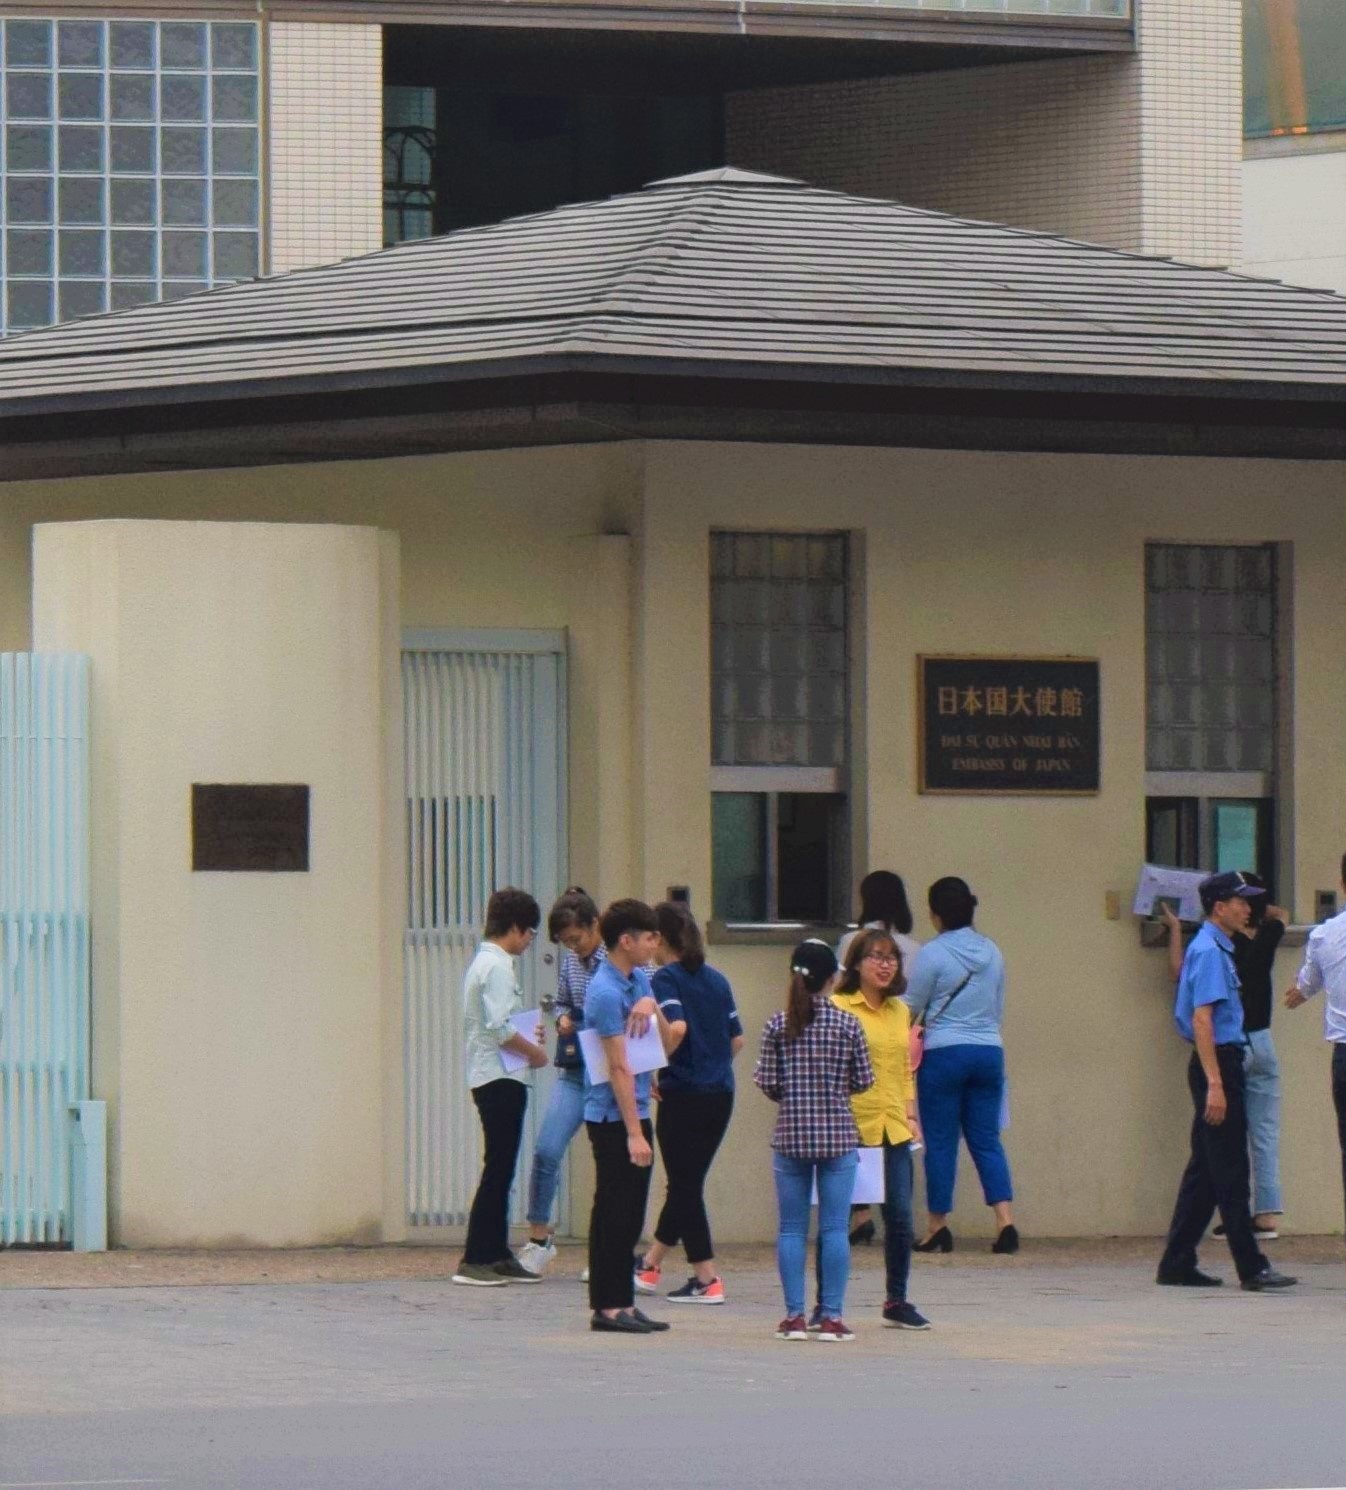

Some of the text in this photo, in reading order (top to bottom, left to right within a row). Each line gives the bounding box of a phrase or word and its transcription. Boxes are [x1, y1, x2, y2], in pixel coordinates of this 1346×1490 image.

[938, 686, 1084, 716] 日本国大使館
[951, 757, 1072, 771] EMBASSY OF JAPAN
